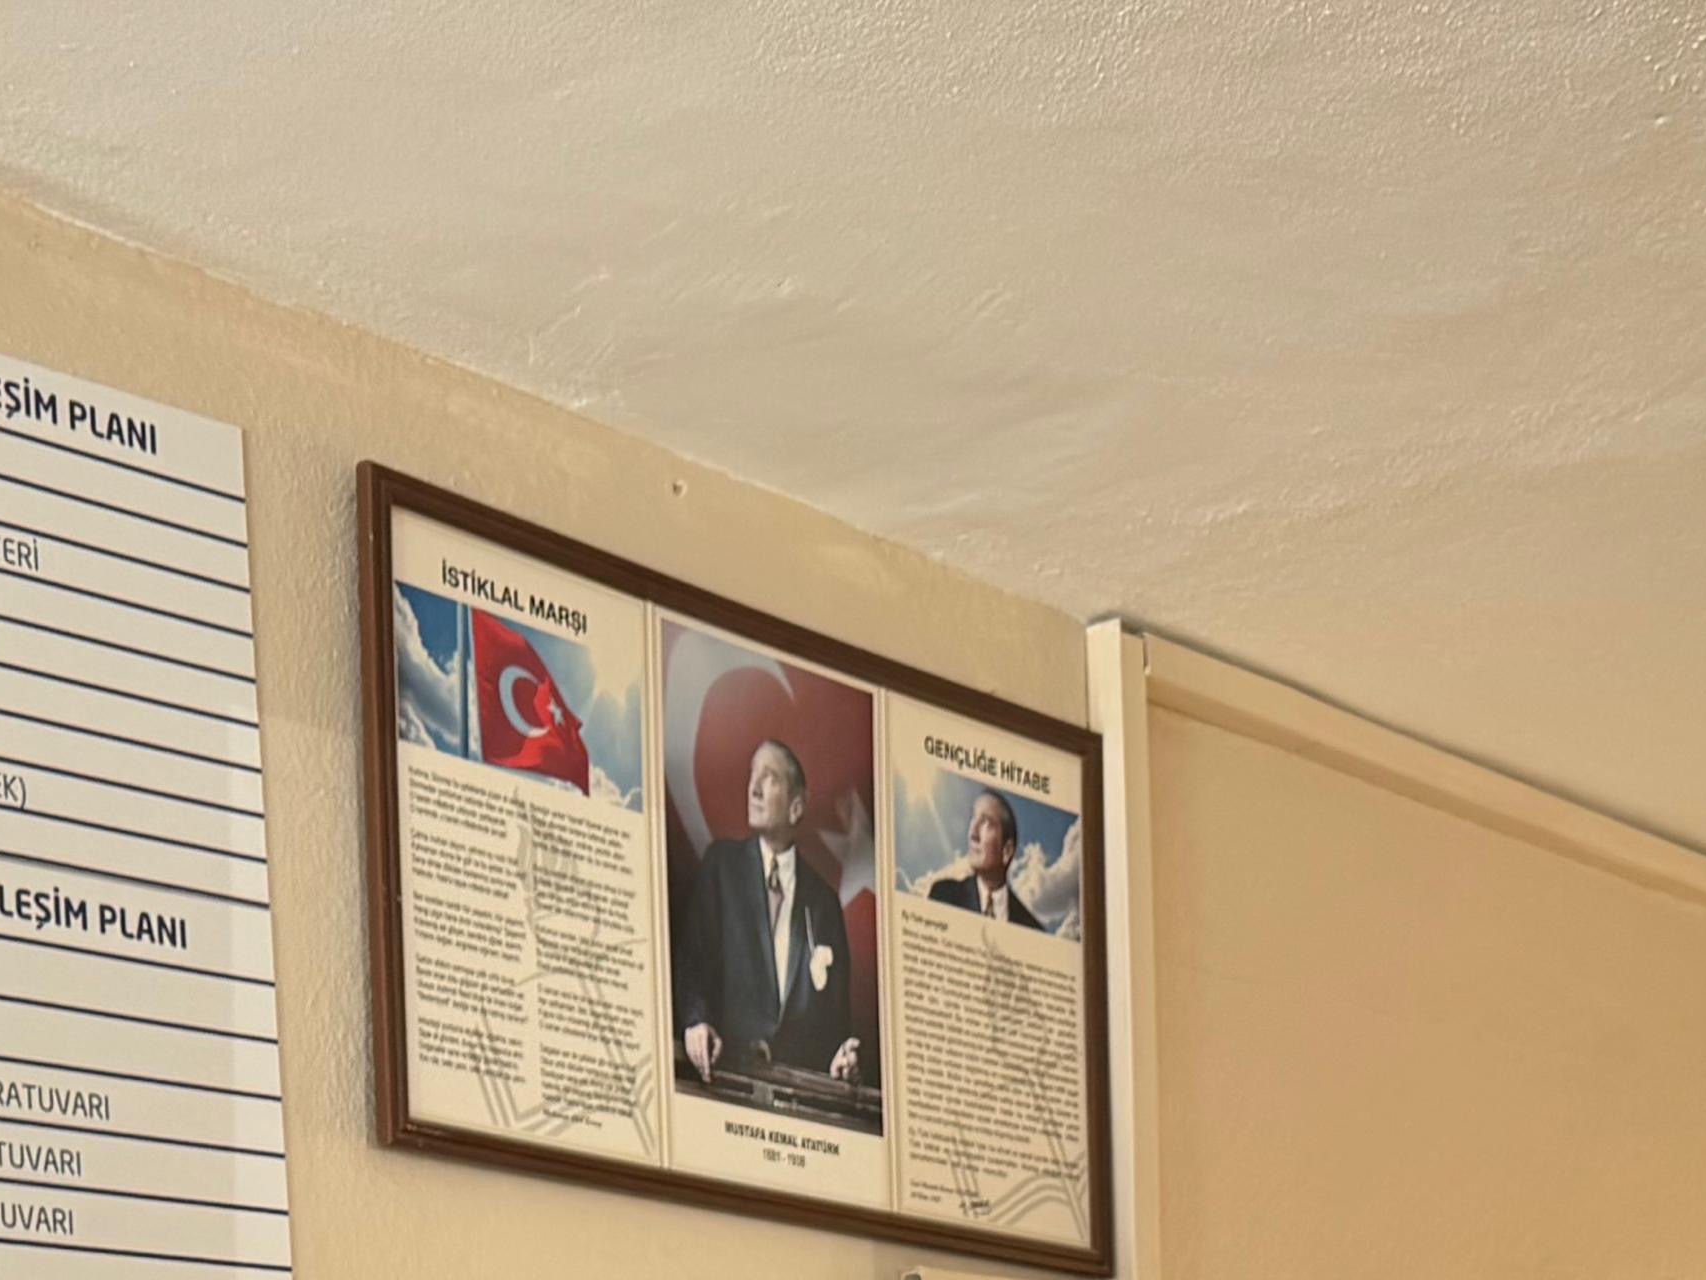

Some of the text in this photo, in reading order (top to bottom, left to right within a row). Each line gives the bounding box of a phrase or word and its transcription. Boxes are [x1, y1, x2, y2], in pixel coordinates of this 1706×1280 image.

[69, 400, 156, 455] PLANI
[442, 558, 587, 636] İSTİKLAL MARŞI
[924, 735, 1050, 794] GENÇLİĞE HİTABE
[100, 907, 187, 949] PLANI
[725, 1120, 840, 1155] MUSTAFA KEMAL ATATÜRK
